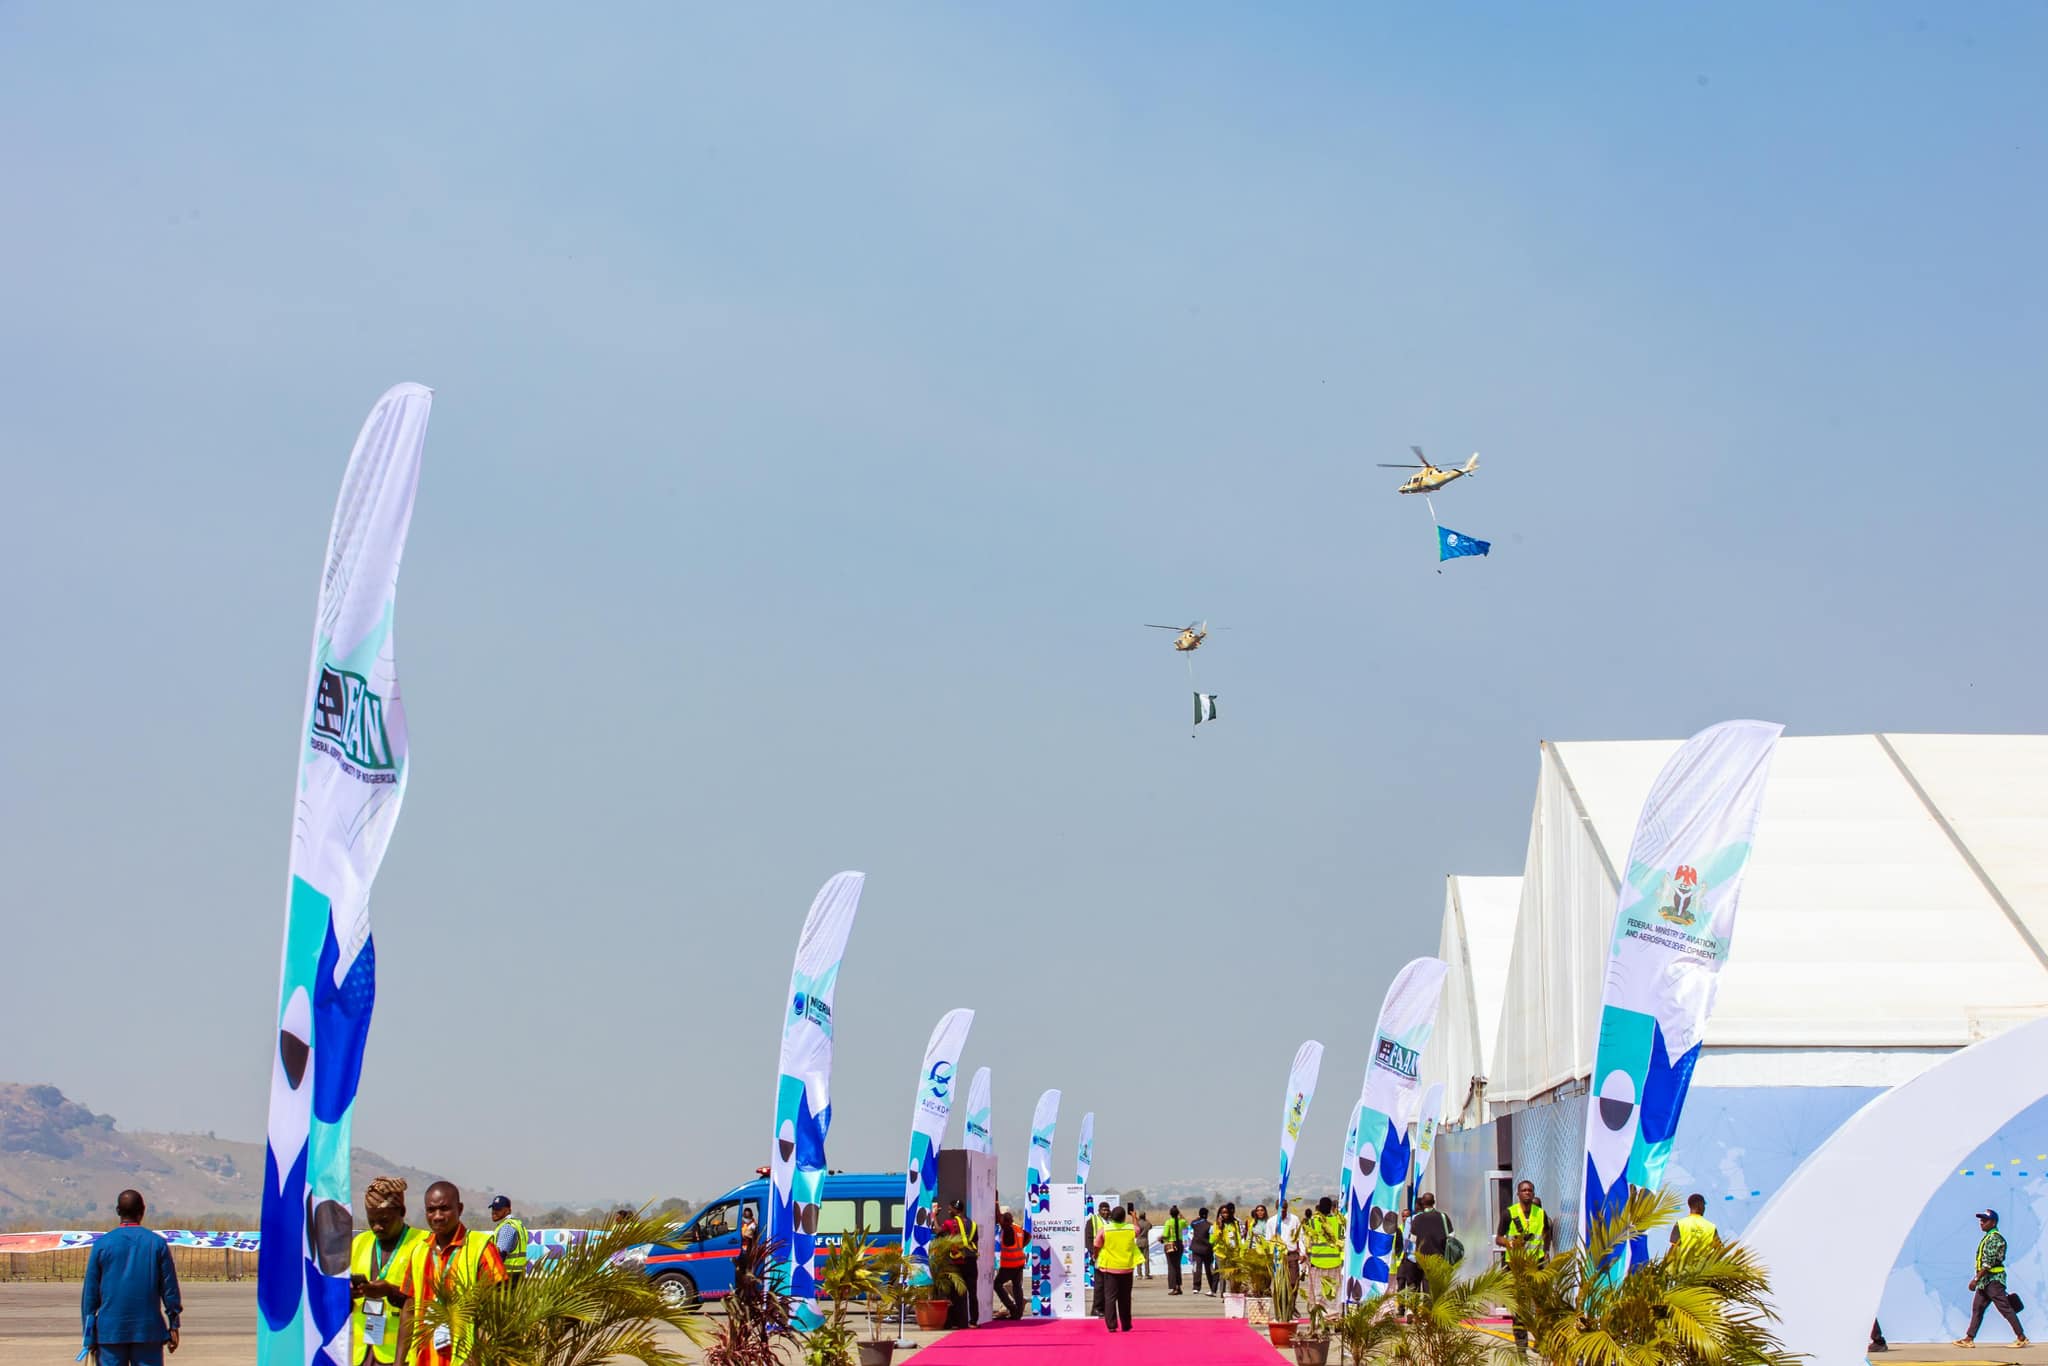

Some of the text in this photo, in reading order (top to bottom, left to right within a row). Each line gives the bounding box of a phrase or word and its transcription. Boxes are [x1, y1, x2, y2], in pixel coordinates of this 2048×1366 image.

[363, 773, 398, 784] NIGERIA
[1626, 929, 1717, 960] AND AEROSPACE DEVELOPMENT
[1627, 918, 1717, 949] FEDERAL MINISTRY OF AVIATION
